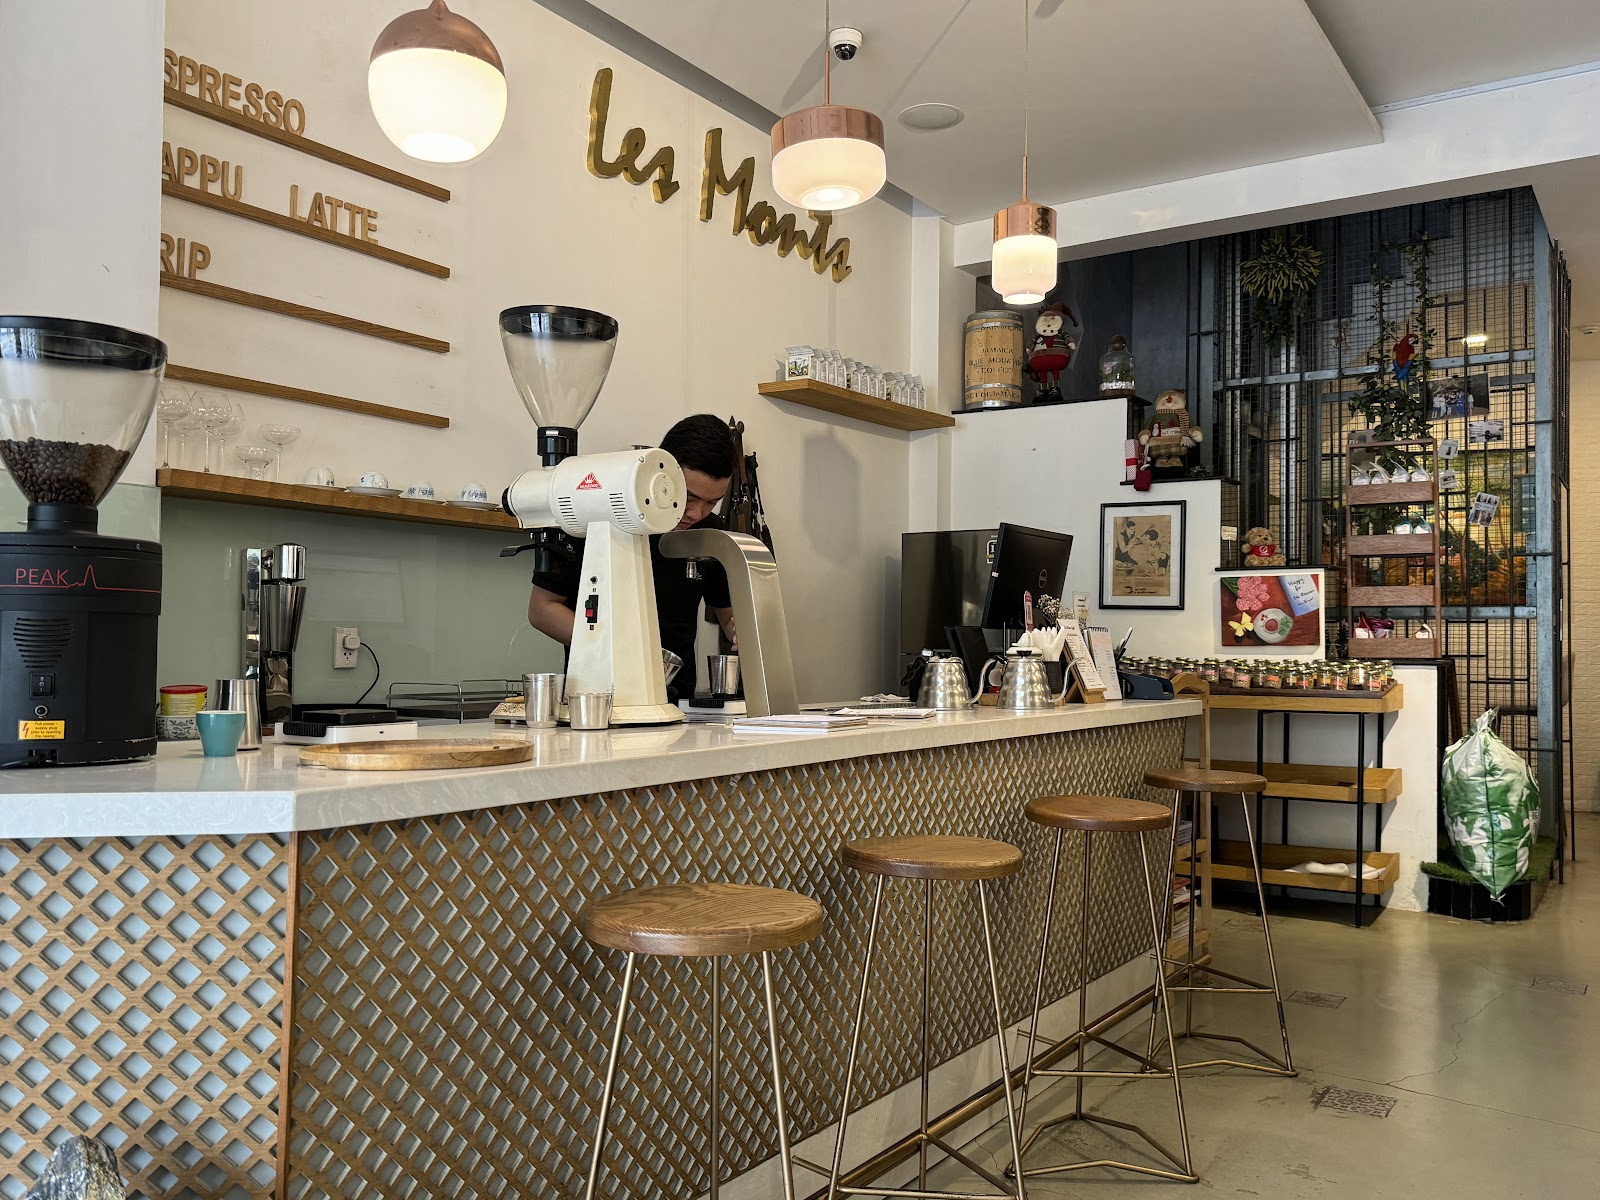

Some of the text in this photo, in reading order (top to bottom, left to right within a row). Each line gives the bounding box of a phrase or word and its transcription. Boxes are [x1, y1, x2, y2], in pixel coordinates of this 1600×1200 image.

[164, 48, 305, 136] SPRESSO
[161, 141, 379, 245] APPU LATTE
[699, 128, 853, 283] Monts
[160, 232, 212, 279] RIP
[15, 568, 69, 585] PEAK
